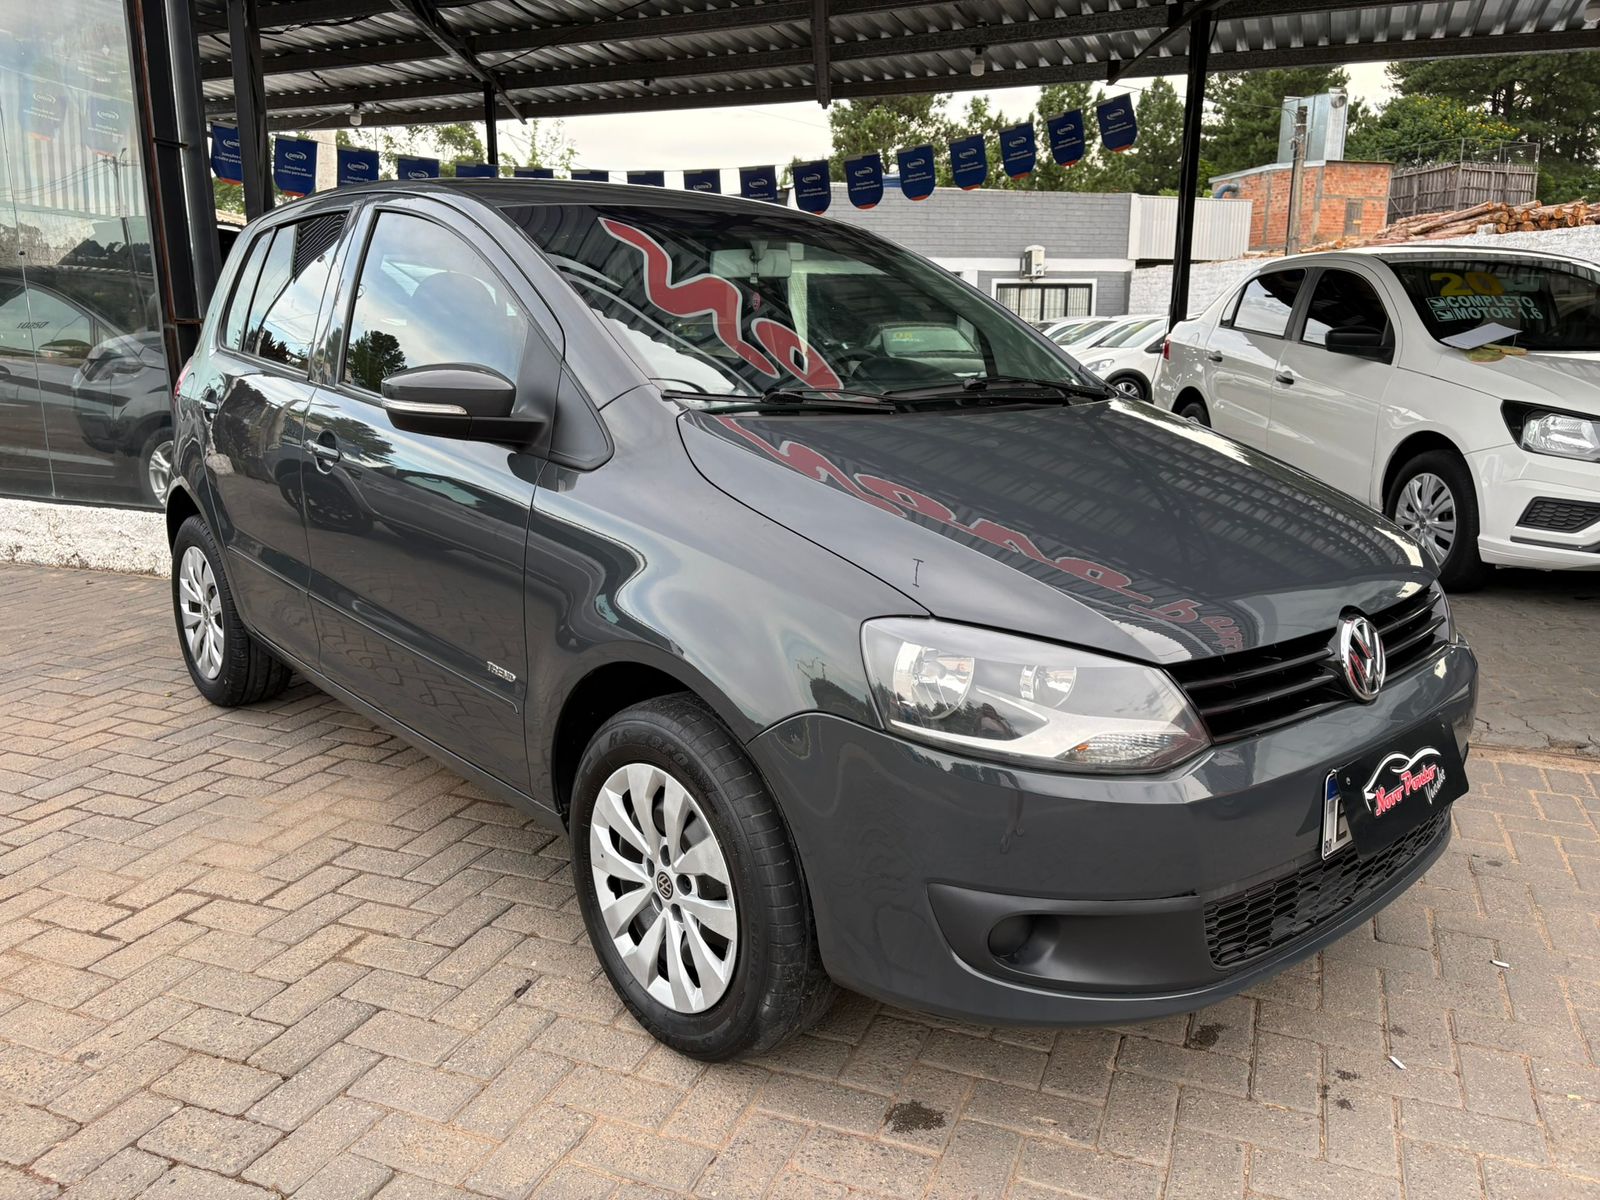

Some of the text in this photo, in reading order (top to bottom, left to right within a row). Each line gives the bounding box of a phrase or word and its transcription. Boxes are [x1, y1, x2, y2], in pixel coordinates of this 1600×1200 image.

[1446, 295, 1535, 308] COMPLETO
[1454, 307, 1544, 321] MOTOR 1.6
[1375, 785, 1405, 817] Novo
